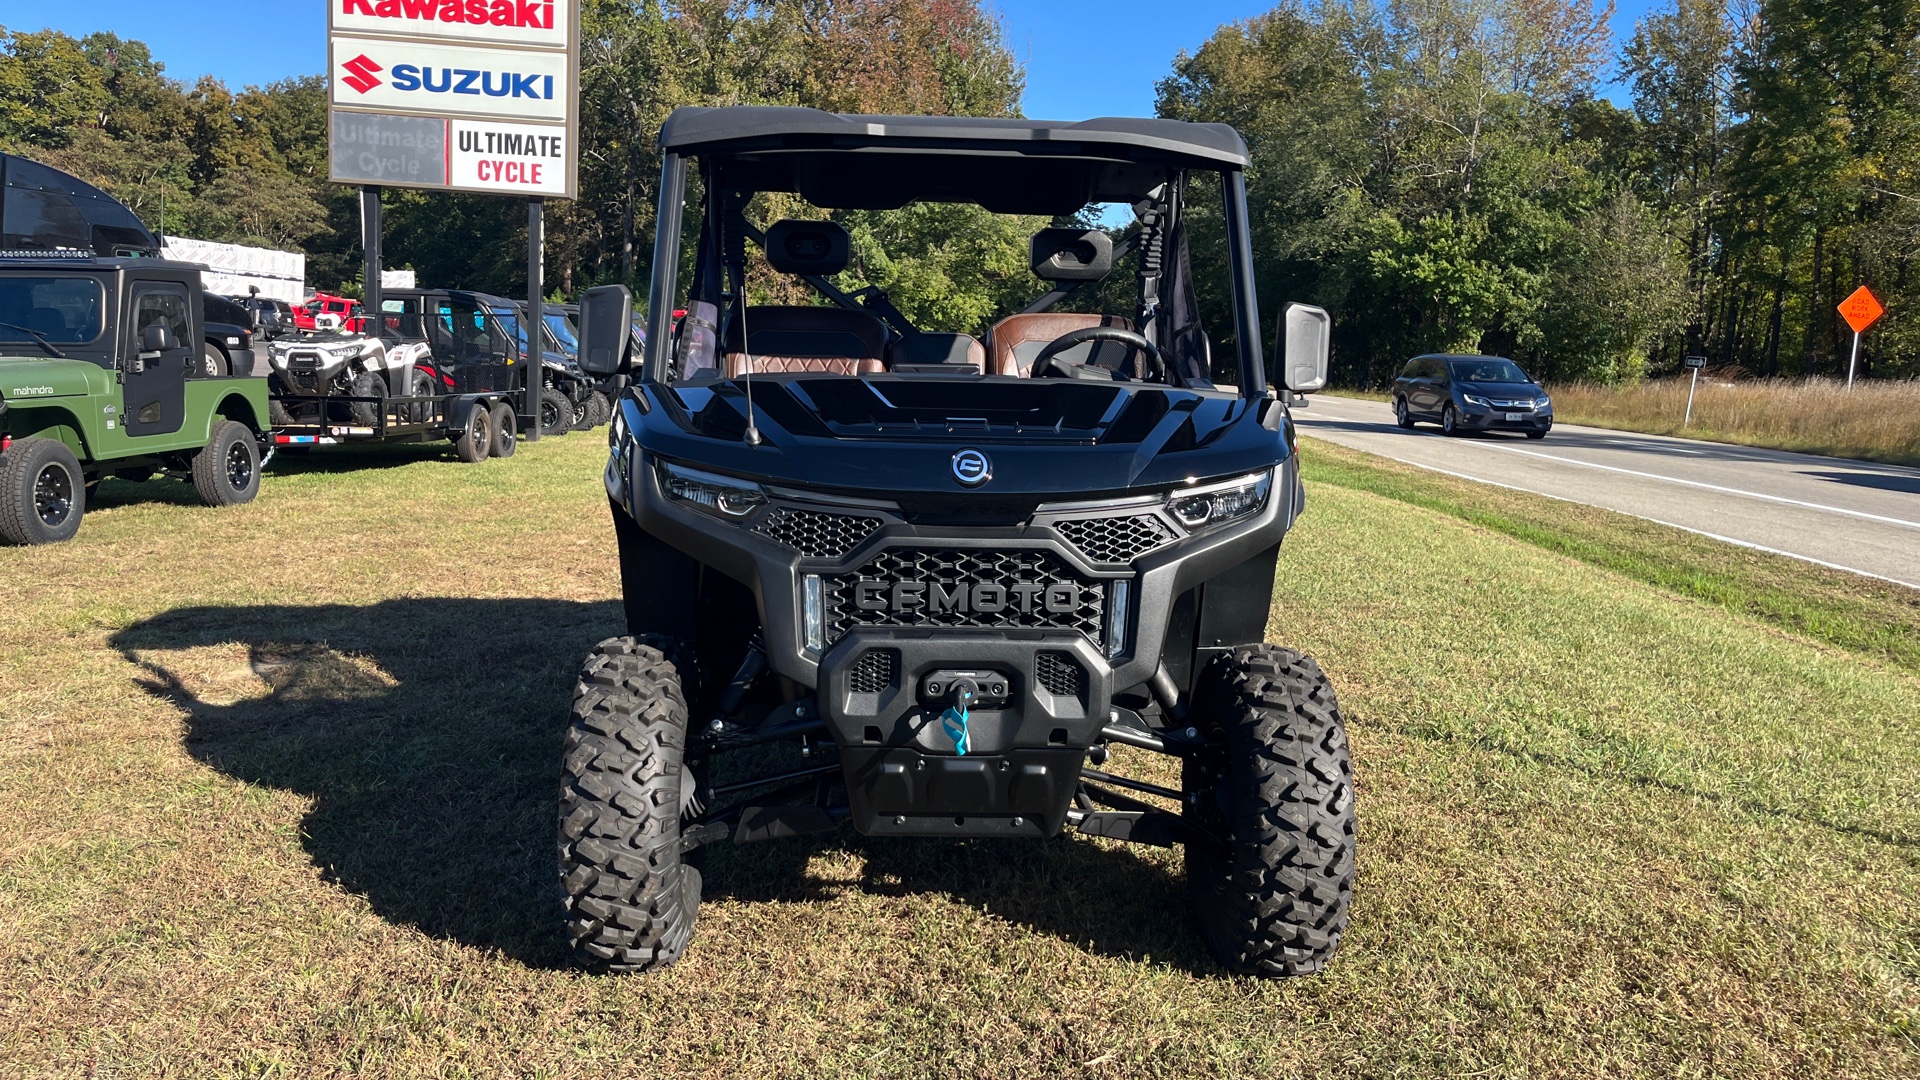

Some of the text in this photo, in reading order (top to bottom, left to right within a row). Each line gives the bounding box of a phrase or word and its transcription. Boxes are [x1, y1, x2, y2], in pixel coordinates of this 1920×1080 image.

[391, 64, 553, 100] SUZUKI
[459, 130, 562, 158] ULTIMATE
[478, 159, 543, 184] CYCLE
[1849, 312, 1870, 320] AHEAD
[13, 385, 54, 396] mahindra
[855, 581, 1080, 613] CFMOTO
